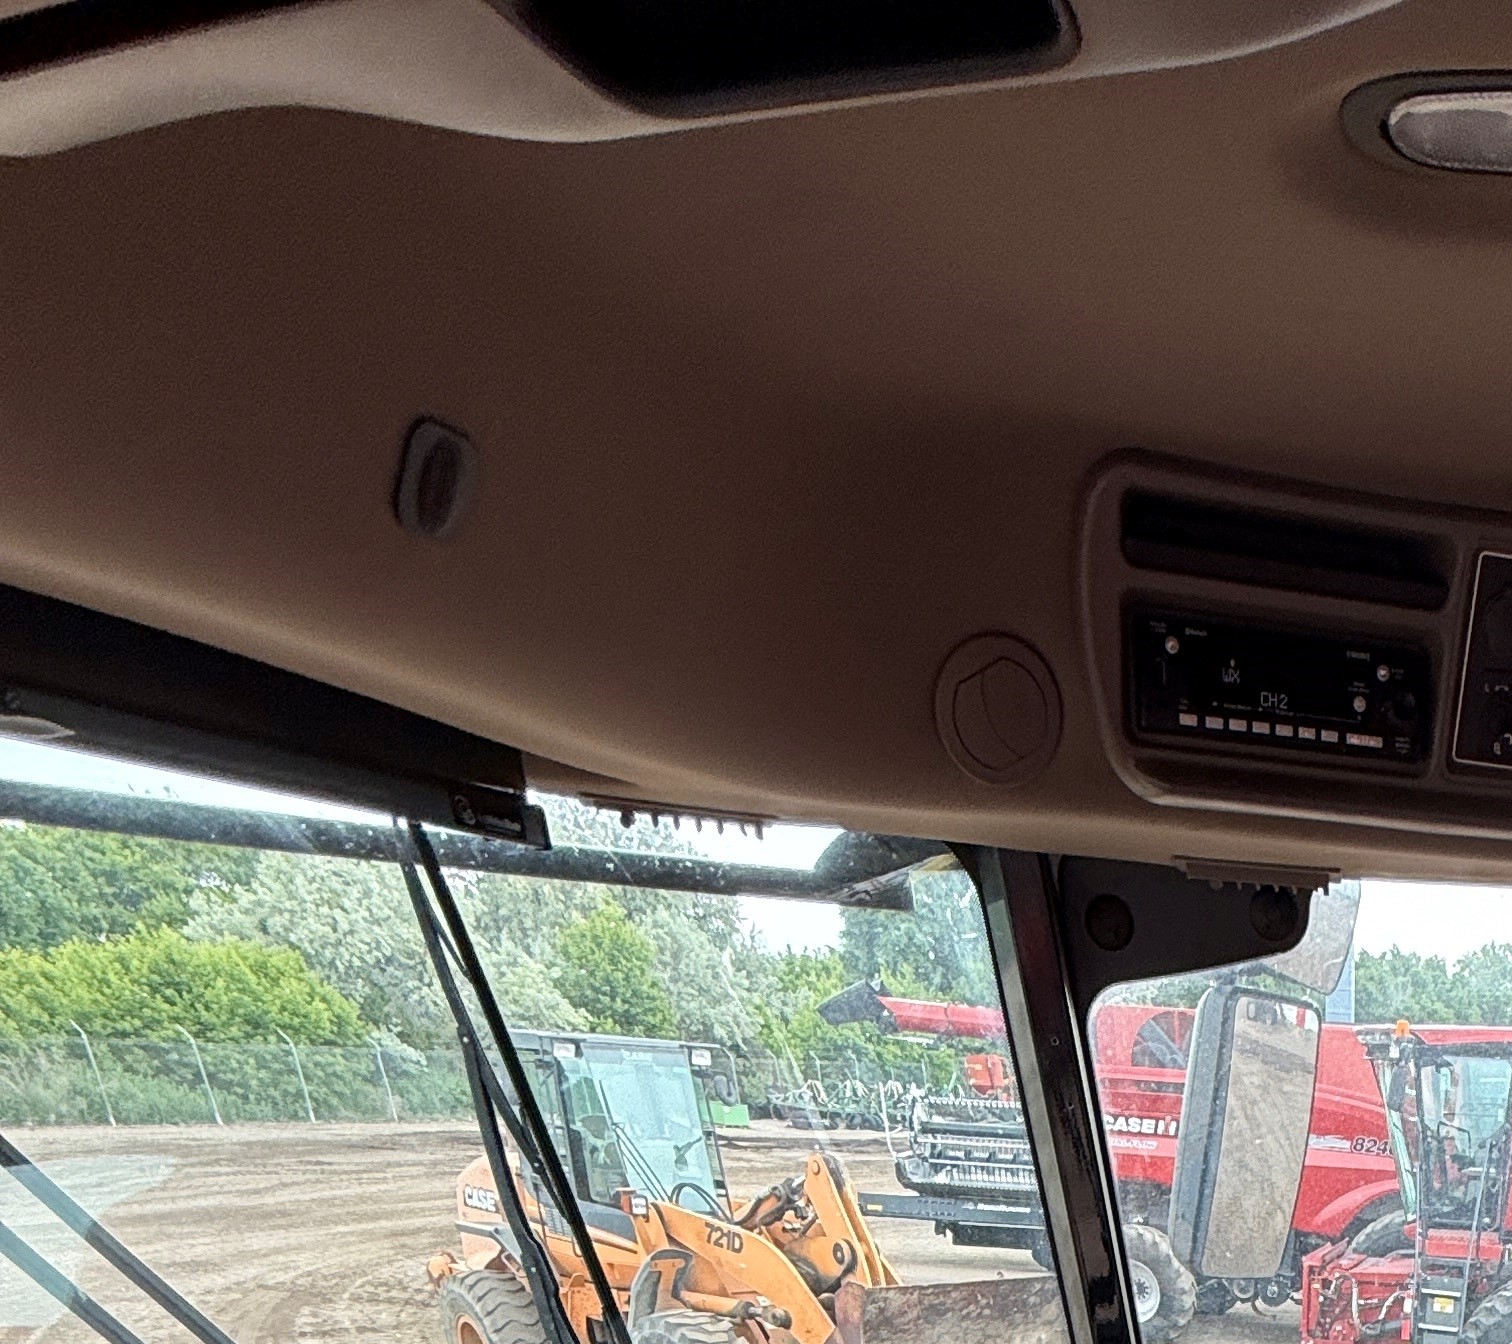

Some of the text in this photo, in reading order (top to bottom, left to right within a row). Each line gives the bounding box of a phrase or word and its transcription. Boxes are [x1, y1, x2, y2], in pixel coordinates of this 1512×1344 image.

[1103, 1114, 1155, 1134] CASE
[1352, 1137, 1393, 1155] 824
[464, 1185, 497, 1213] CASE
[704, 1221, 744, 1254] 721D
